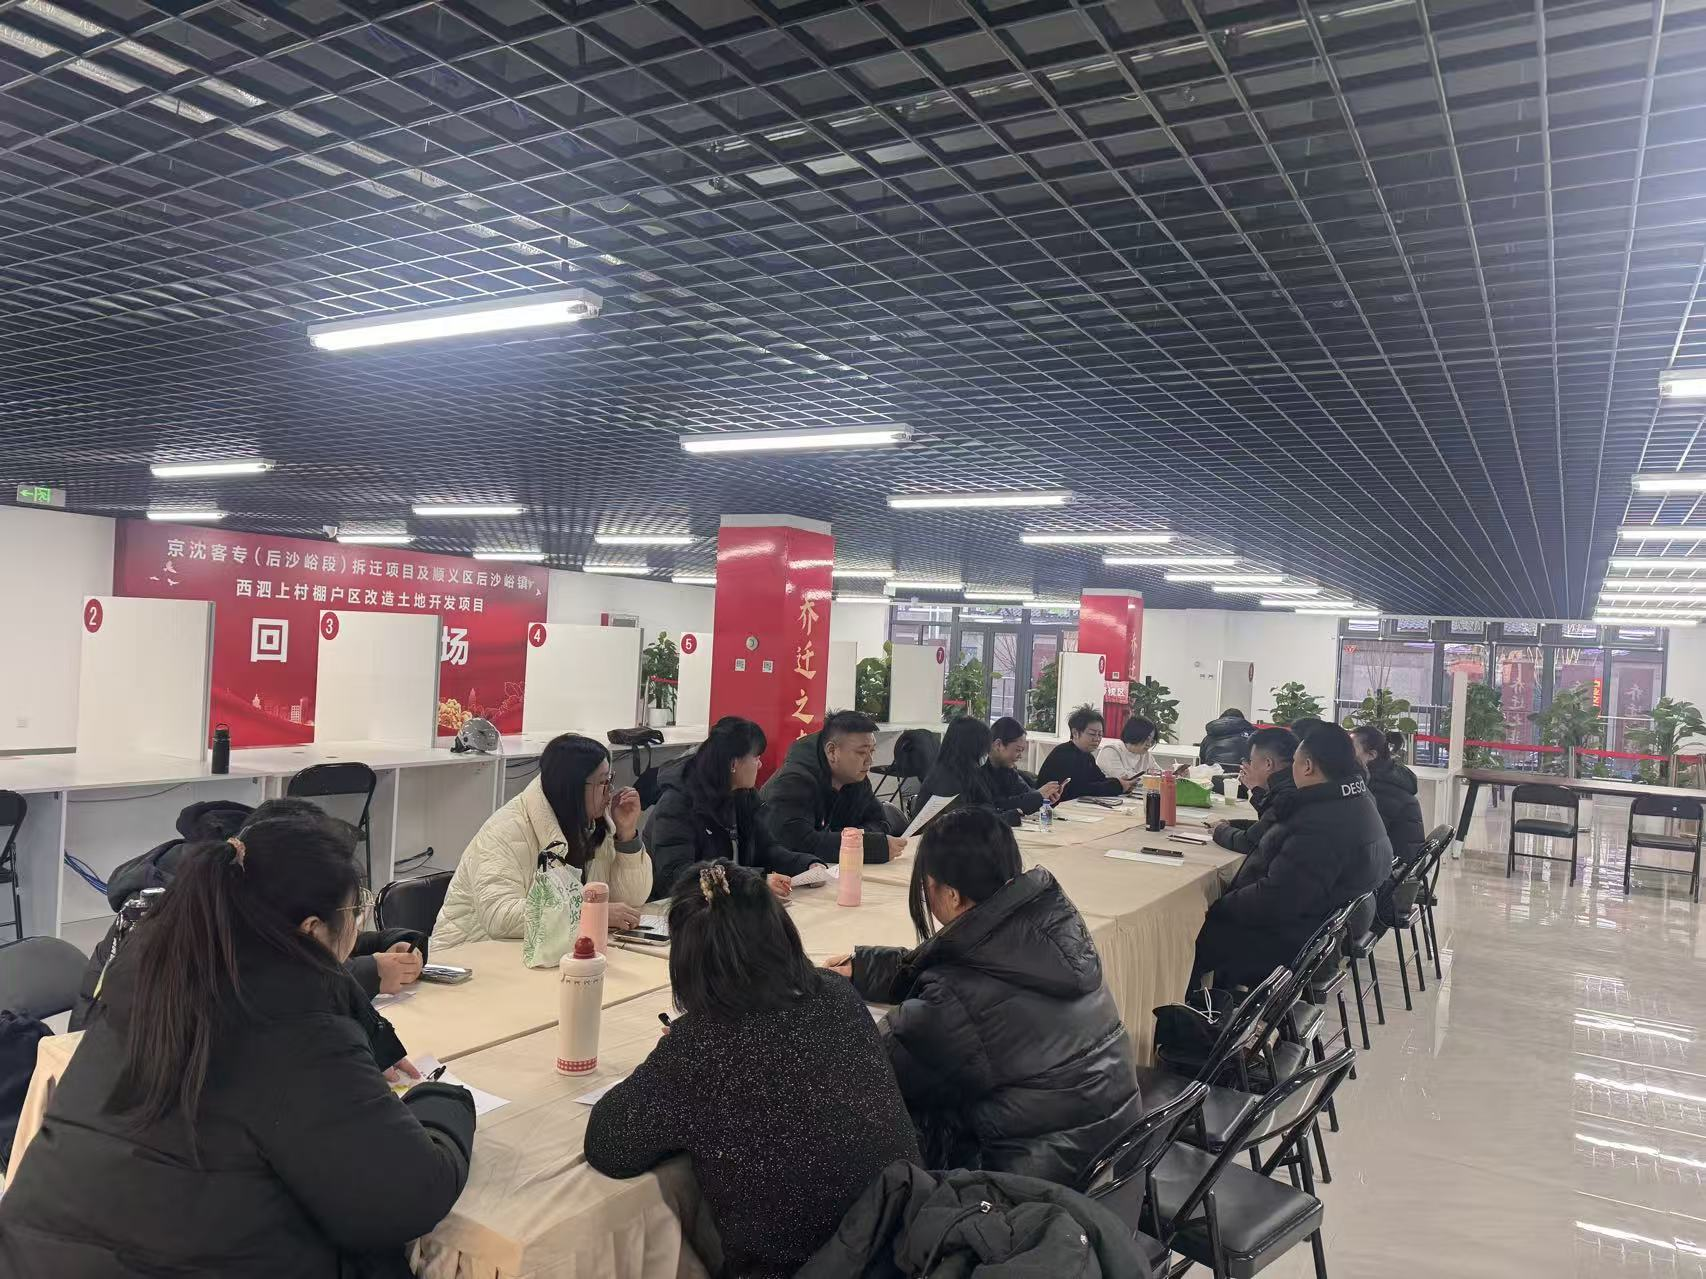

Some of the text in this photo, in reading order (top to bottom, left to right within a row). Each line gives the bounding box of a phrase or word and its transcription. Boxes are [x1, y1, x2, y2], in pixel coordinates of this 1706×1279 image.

[236, 578, 484, 613] 西泗上村棚户区改造土地开发项目
[88, 606, 98, 626] 2
[325, 618, 334, 634] 3
[250, 617, 289, 663] 回
[533, 628, 542, 643] 4
[685, 638, 693, 650] 5
[792, 597, 819, 740] 乔迁之
